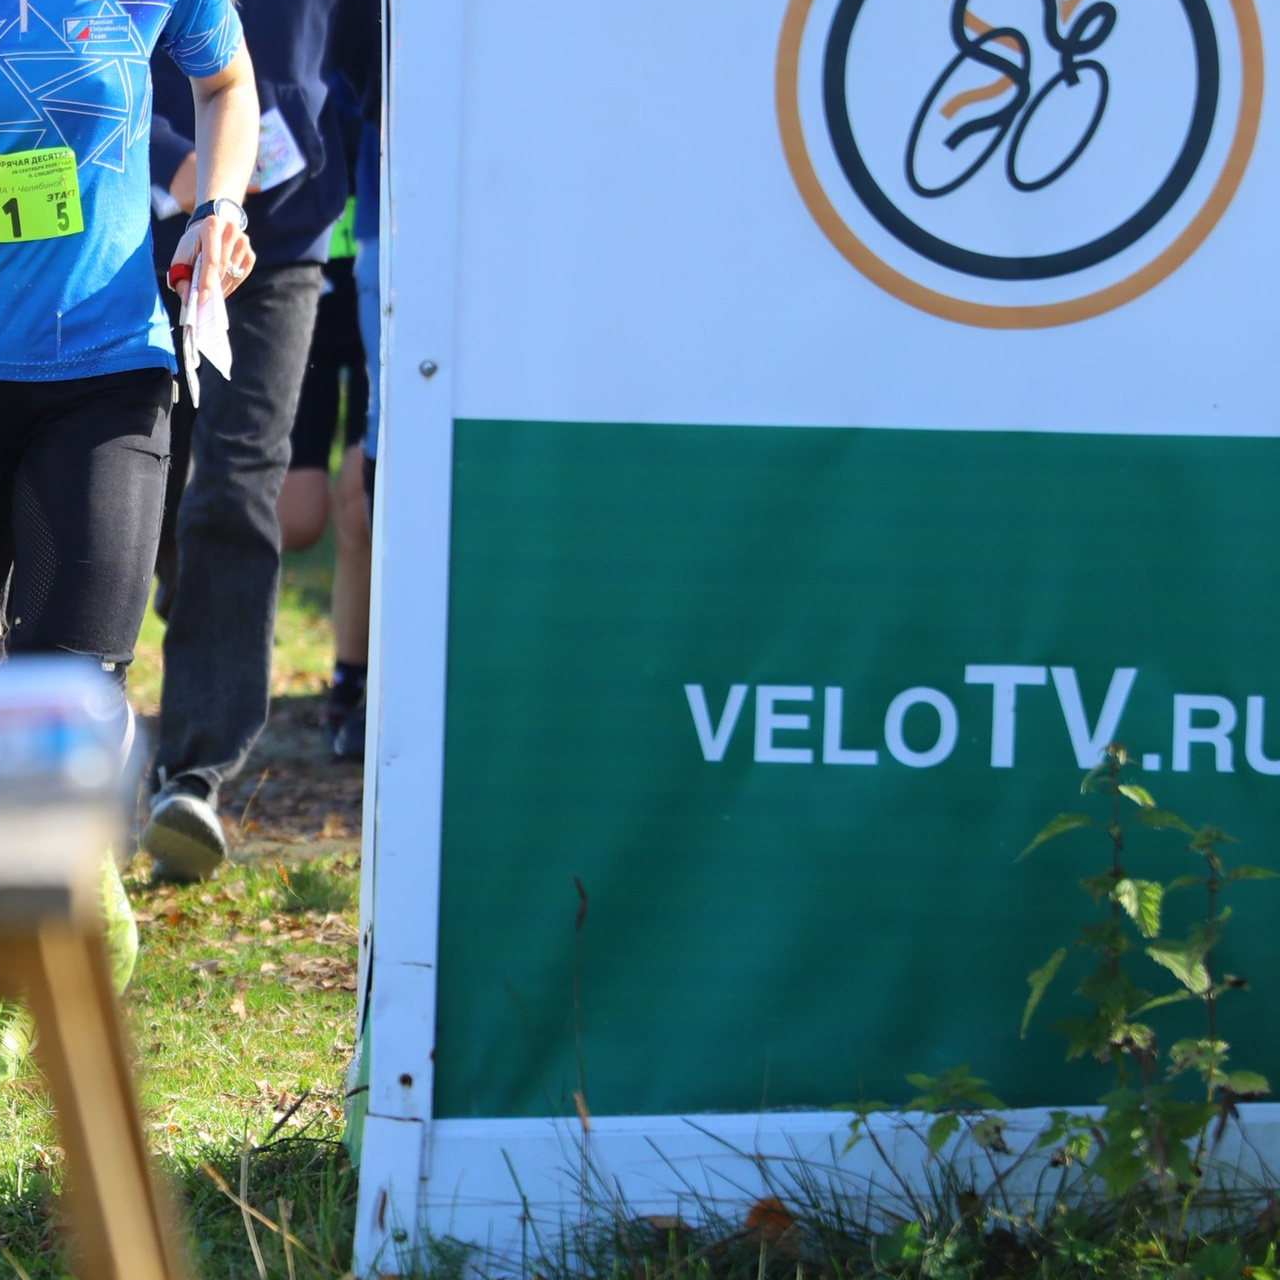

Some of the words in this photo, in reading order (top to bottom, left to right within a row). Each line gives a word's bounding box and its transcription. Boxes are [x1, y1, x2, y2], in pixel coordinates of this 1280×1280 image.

[31, 150, 70, 165] ДЕСЯТКА
[18, 181, 63, 193] Челябинск
[46, 189, 75, 202] ЭТАП
[2, 198, 22, 238] 1
[56, 201, 70, 231] 5
